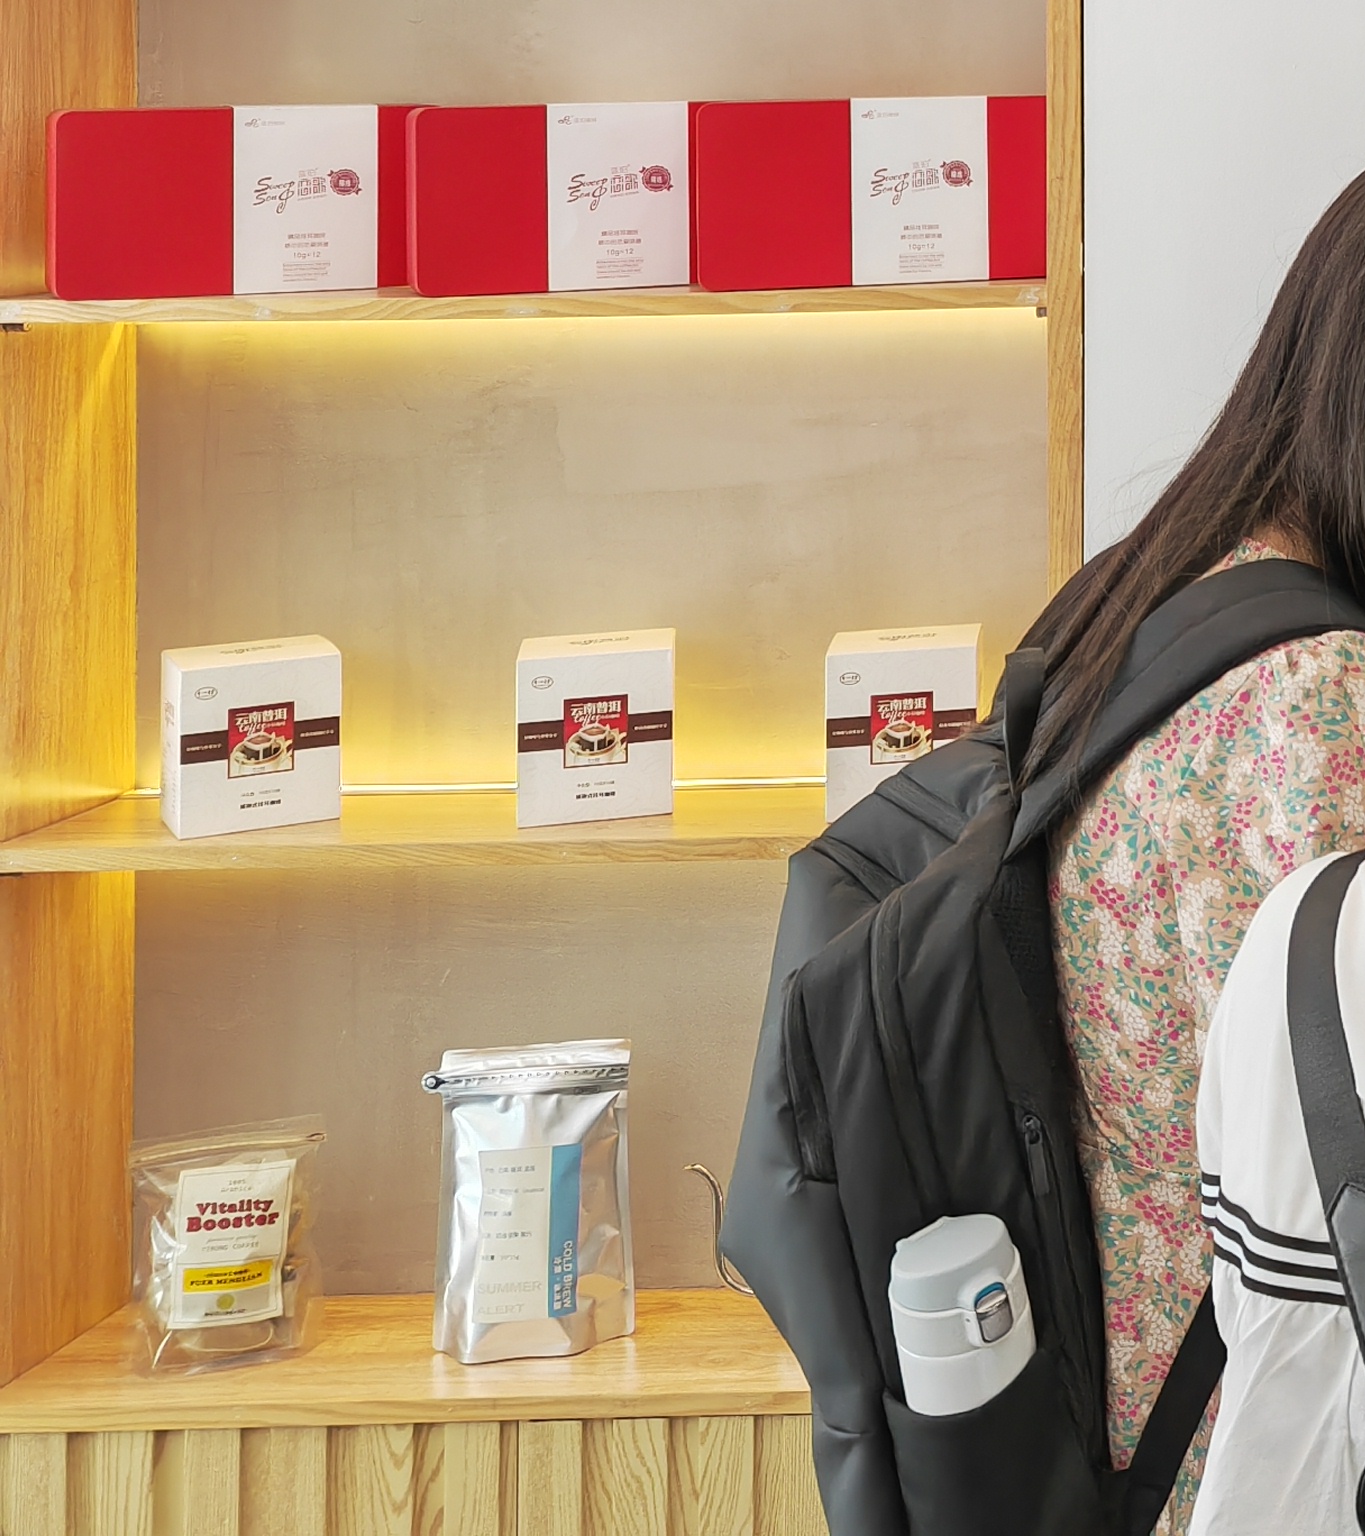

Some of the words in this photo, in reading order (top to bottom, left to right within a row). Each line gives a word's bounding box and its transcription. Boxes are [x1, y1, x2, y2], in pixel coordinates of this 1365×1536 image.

[570, 699, 622, 716] 云南普洱
[877, 696, 927, 712] 云南普洱
[235, 707, 288, 725] 云南普洱
[195, 1198, 275, 1216] Vitality
[186, 1212, 280, 1233] Booster
[477, 1280, 543, 1296] SUMMER
[477, 1302, 525, 1316] ALERT
